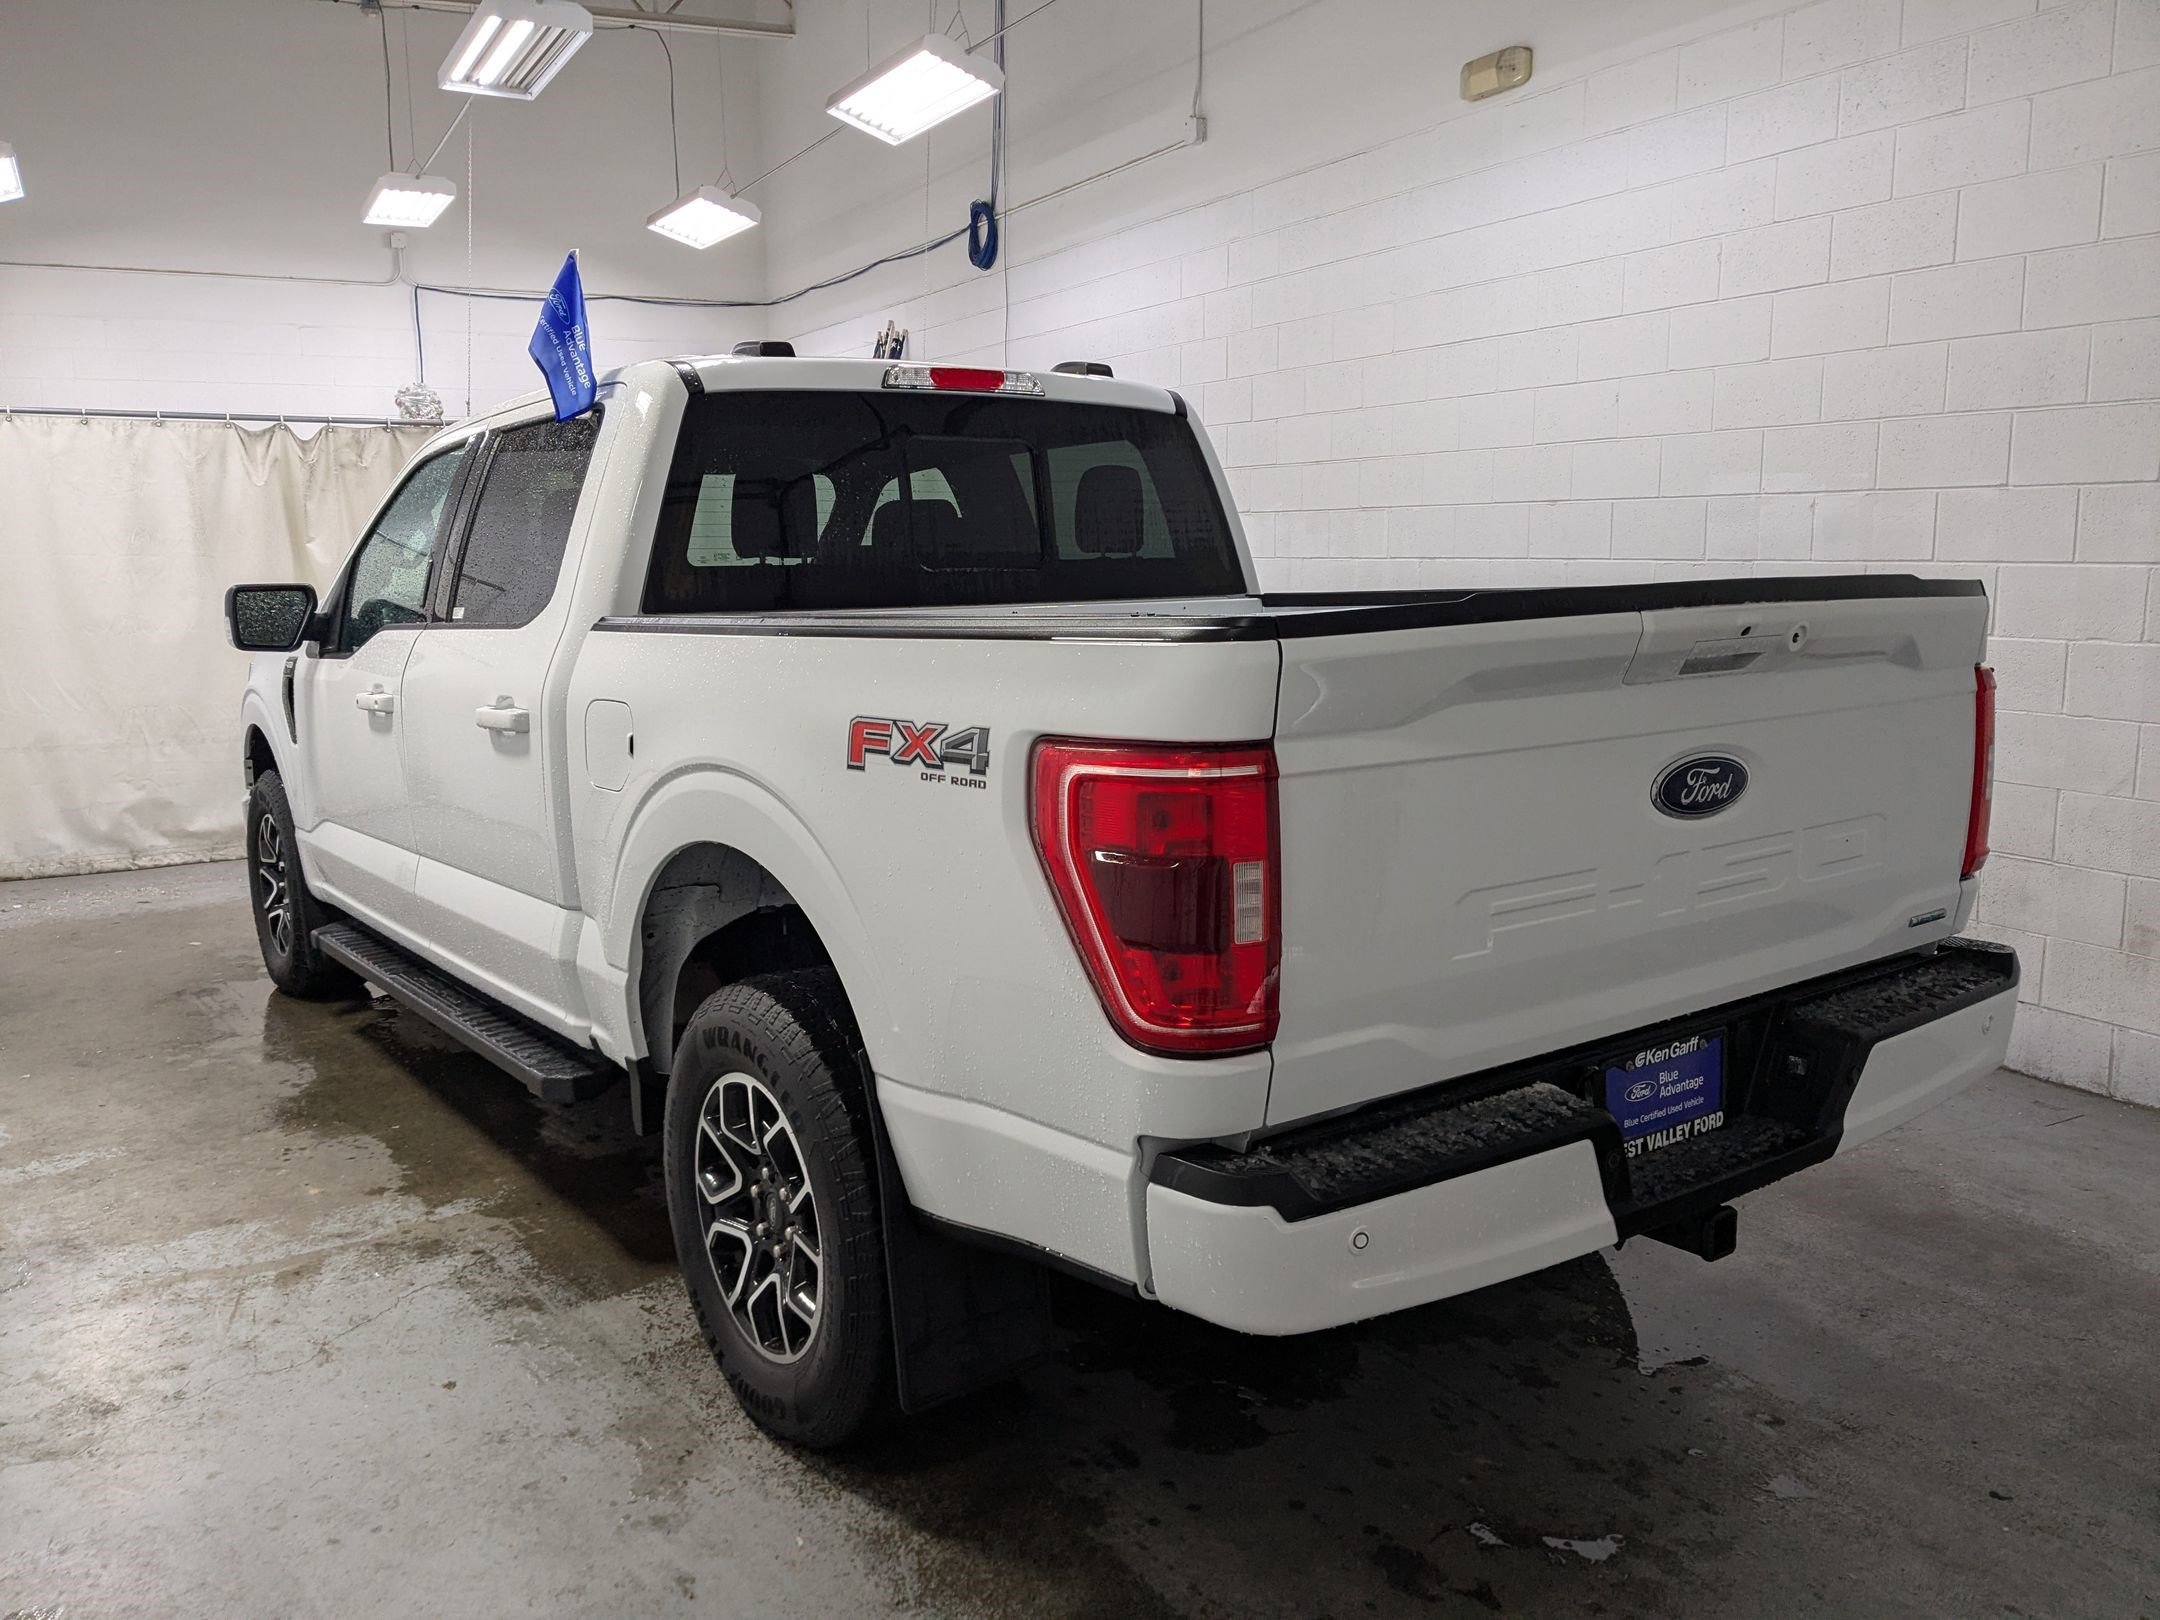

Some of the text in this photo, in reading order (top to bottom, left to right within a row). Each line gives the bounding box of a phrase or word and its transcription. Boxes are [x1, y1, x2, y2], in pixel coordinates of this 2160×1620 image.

[549, 291, 568, 319] Ford
[571, 324, 586, 352] Blue
[556, 345, 567, 367] Used
[563, 367, 577, 397] Vehicle
[563, 330, 591, 389] Advantage
[846, 714, 991, 777] FX4
[920, 772, 987, 790] OFF ROAD
[1680, 766, 1734, 805] Ford
[1645, 1036, 1700, 1066] Ken Garff
[1630, 1084, 1652, 1100] Ford
[1659, 1070, 1679, 1085] Blue
[1659, 1075, 1704, 1099] Advantage
[1623, 1096, 1704, 1128] Blue Certified Used Vehicle
[1646, 1123, 1691, 1152] VALLEY
[1693, 1112, 1723, 1136] FORD
